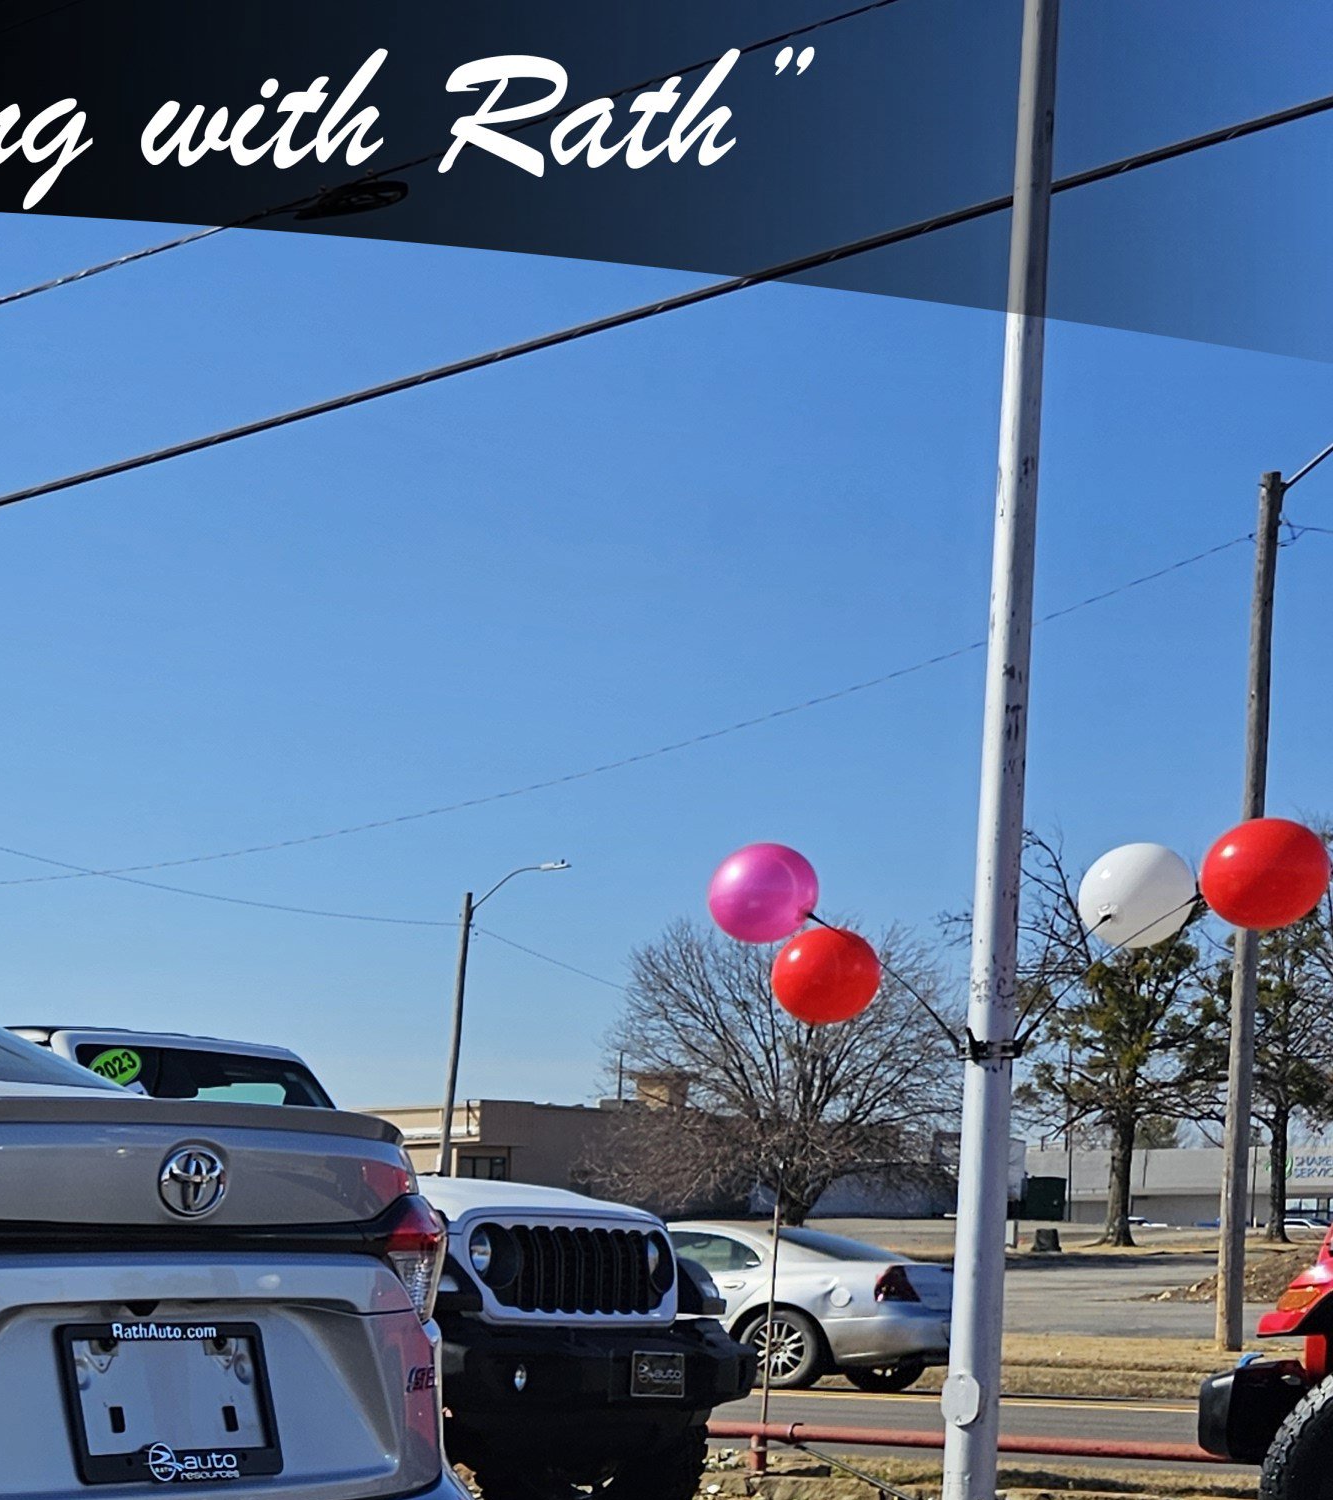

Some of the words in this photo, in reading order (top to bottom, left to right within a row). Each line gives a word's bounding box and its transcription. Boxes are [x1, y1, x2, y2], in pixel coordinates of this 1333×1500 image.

[112, 1322, 217, 1339] RathAuto.com
[183, 1452, 237, 1470] auto
[180, 1469, 240, 1480] resources
